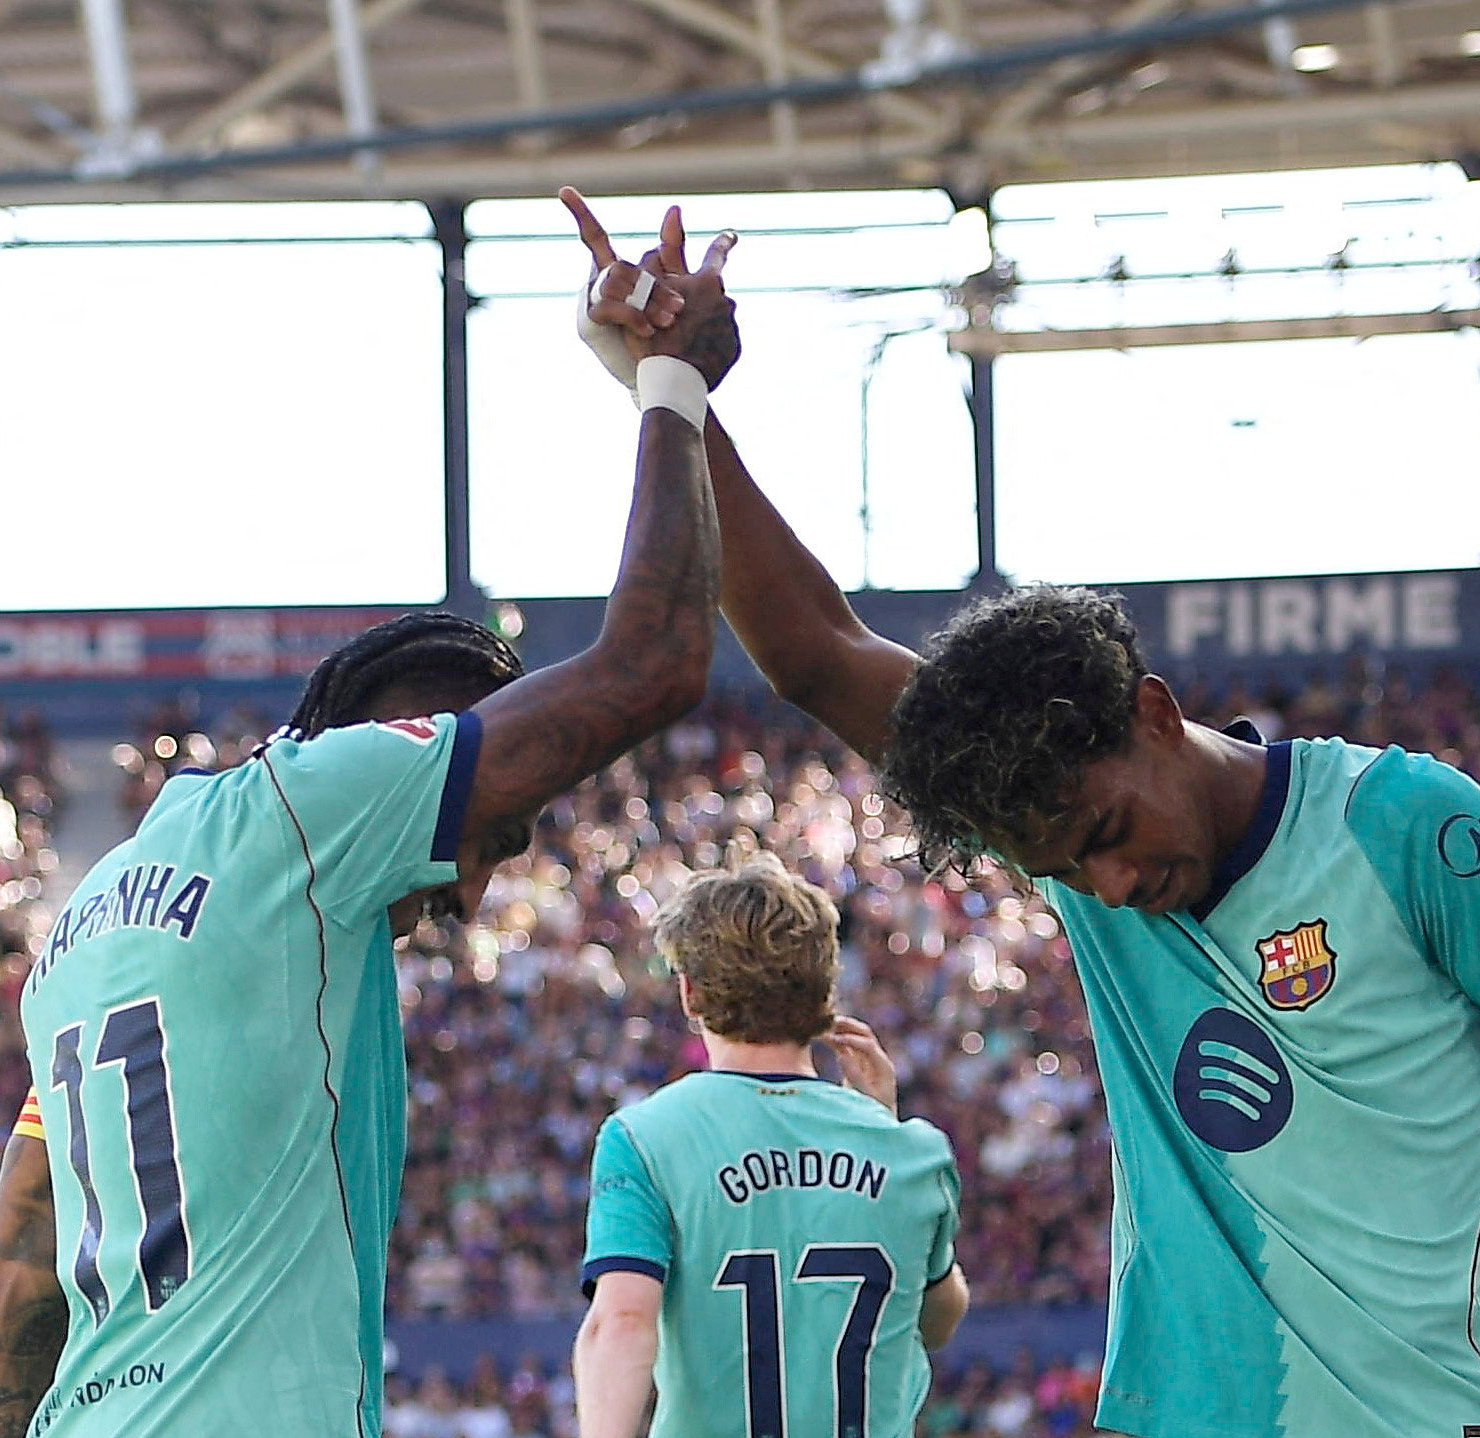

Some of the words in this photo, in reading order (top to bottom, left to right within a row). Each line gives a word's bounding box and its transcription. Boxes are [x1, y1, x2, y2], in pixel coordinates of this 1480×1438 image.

[1165, 573, 1461, 657] FIRME
[52, 996, 193, 1331] 11
[719, 1148, 888, 1204] GORDON
